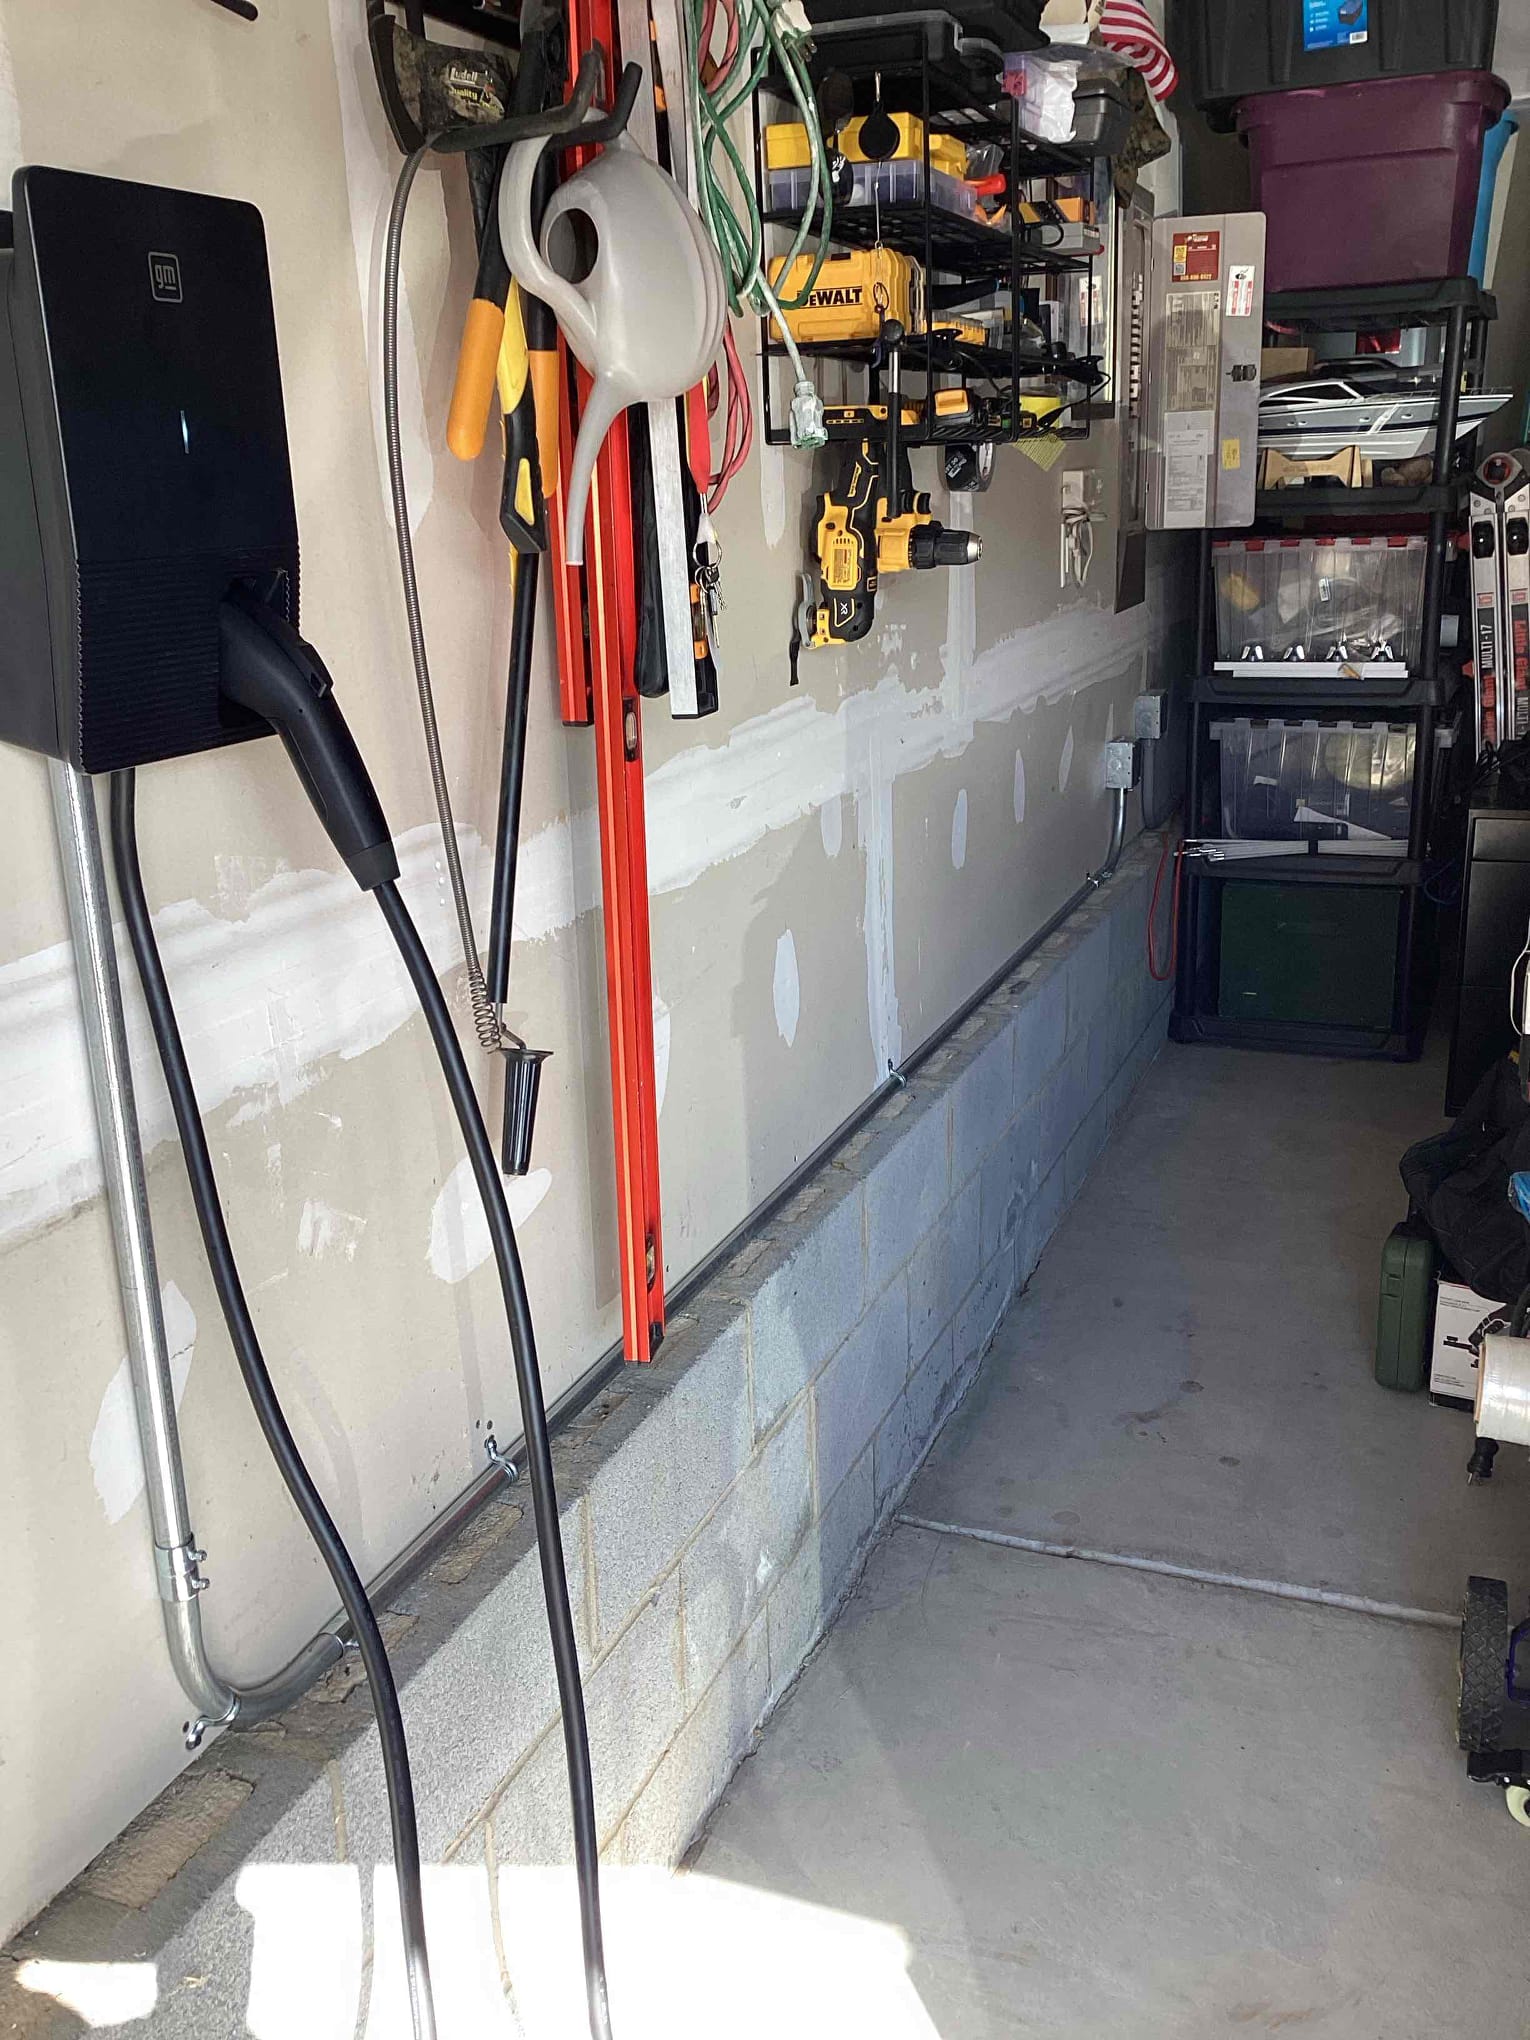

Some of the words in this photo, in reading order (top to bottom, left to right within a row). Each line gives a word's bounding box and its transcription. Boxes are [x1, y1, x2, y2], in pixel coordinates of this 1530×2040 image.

[451, 87, 478, 101] uality
[154, 264, 176, 290] gm
[797, 288, 862, 306] EWALT
